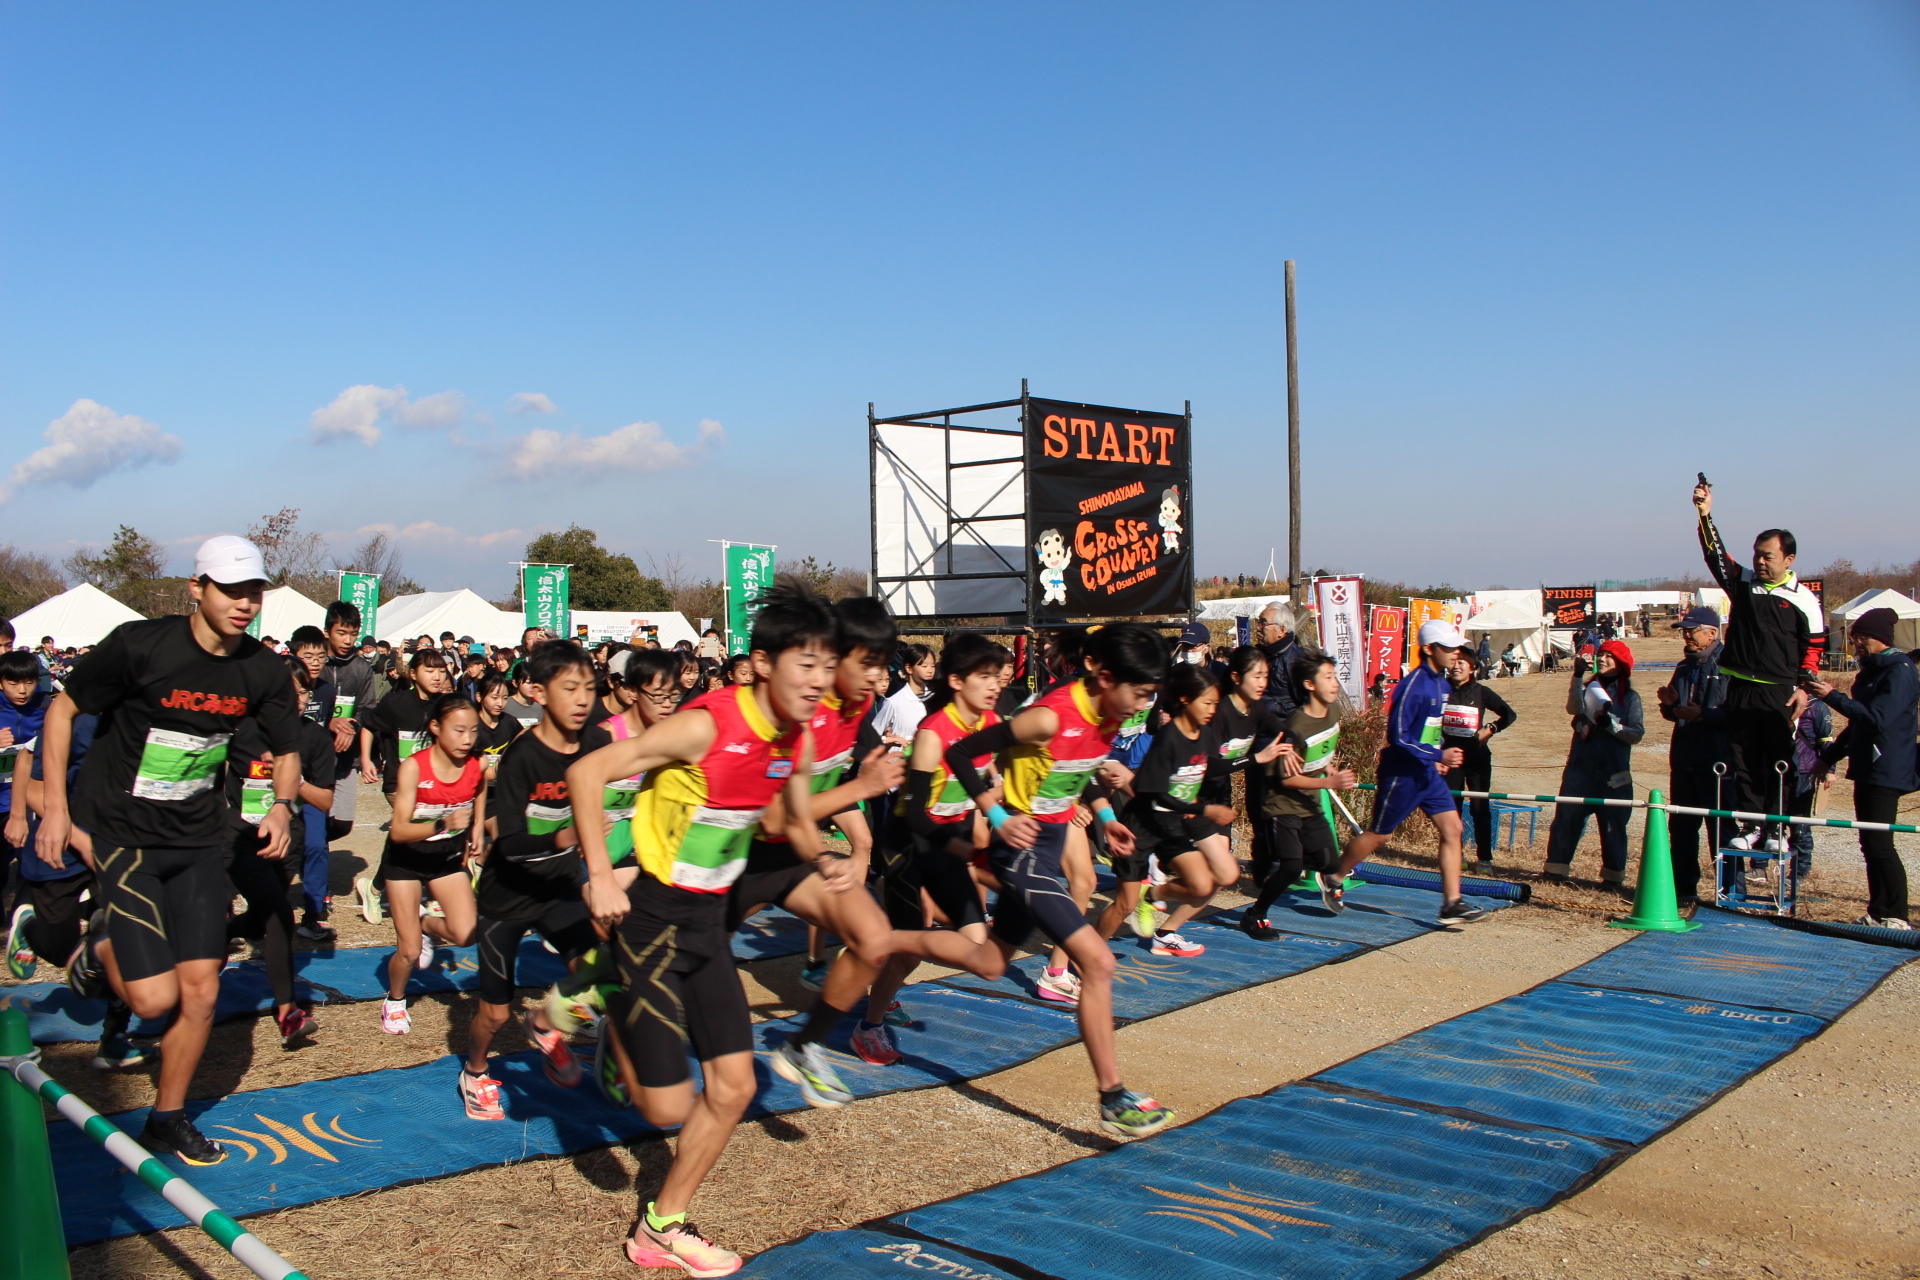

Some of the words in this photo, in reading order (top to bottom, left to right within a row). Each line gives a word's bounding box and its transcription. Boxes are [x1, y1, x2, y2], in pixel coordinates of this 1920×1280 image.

[1043, 414, 1175, 466] START
[1078, 481, 1146, 516] SHINODAYAMA
[1080, 533, 1160, 592] COUNTRY
[1107, 584, 1116, 595] IN
[1116, 576, 1137, 591] OSAKA
[1136, 565, 1157, 583] IZUMI
[1545, 588, 1595, 599] FINISH
[1334, 612, 1351, 683] 桃山学院大学
[160, 688, 248, 716] JRCみはら
[1171, 783, 1193, 800] 55
